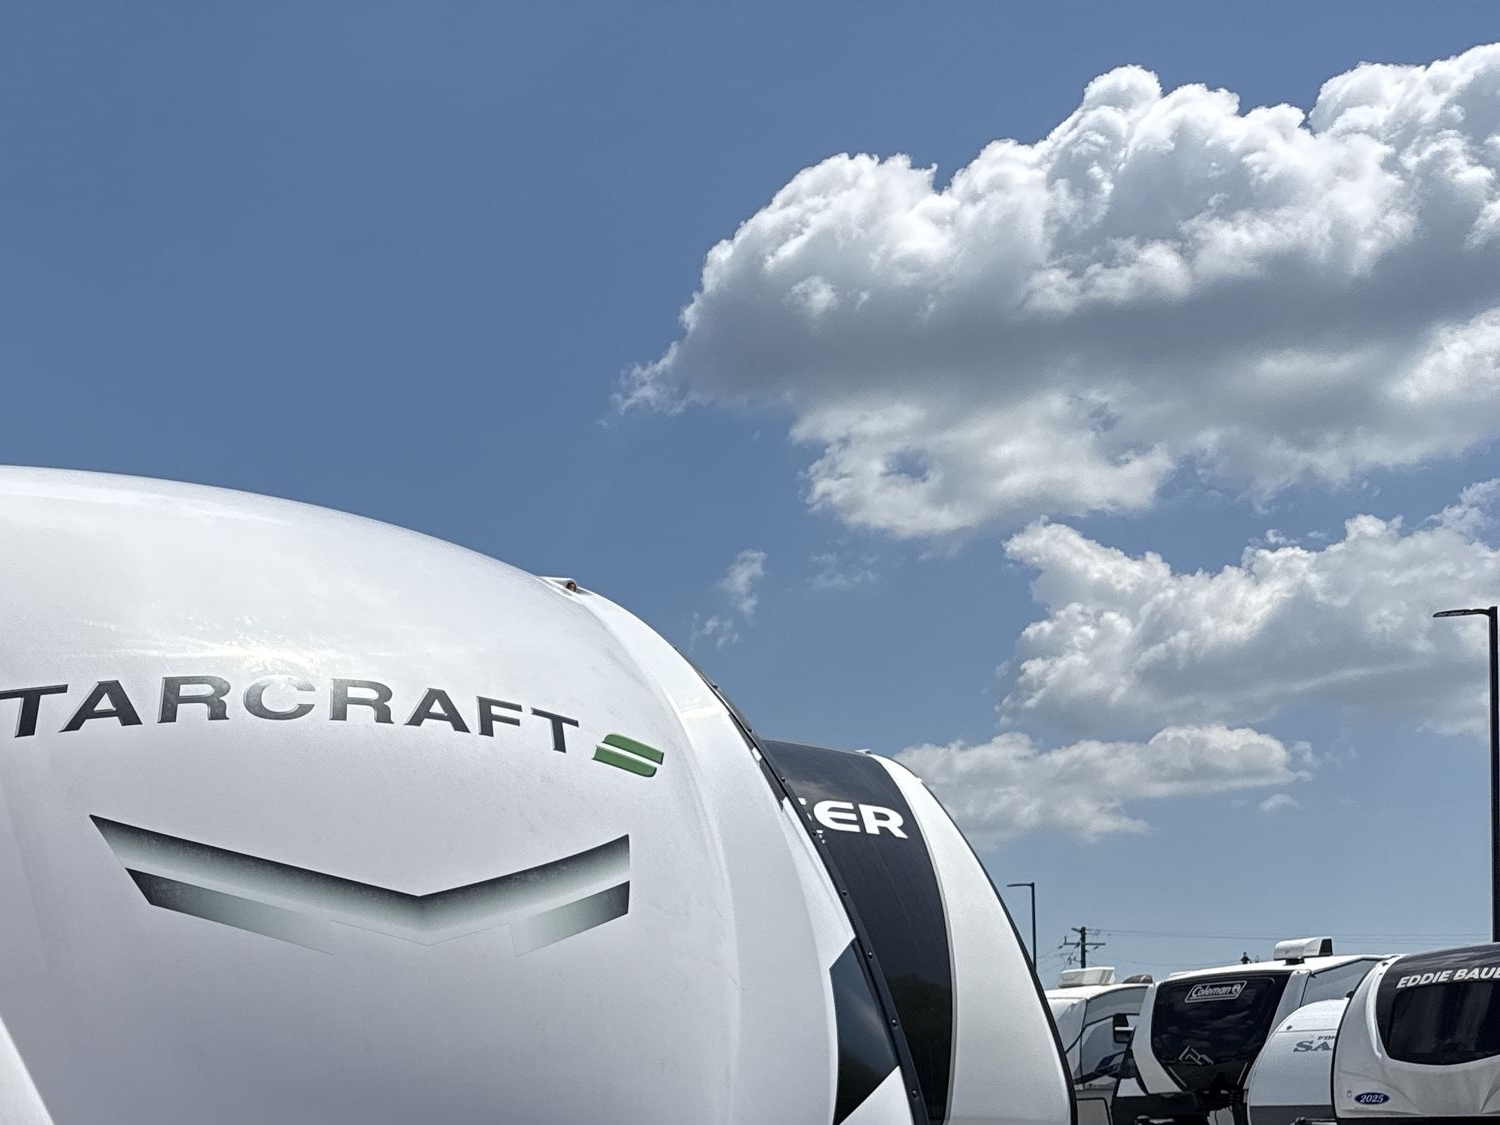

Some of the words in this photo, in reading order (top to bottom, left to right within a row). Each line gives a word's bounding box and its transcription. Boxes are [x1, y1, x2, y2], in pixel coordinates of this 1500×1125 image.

[798, 798, 908, 838] ER
[1396, 971, 1452, 989] EDDIE
[1192, 984, 1231, 997] Coleman
[1360, 1094, 1384, 1103] 2025
